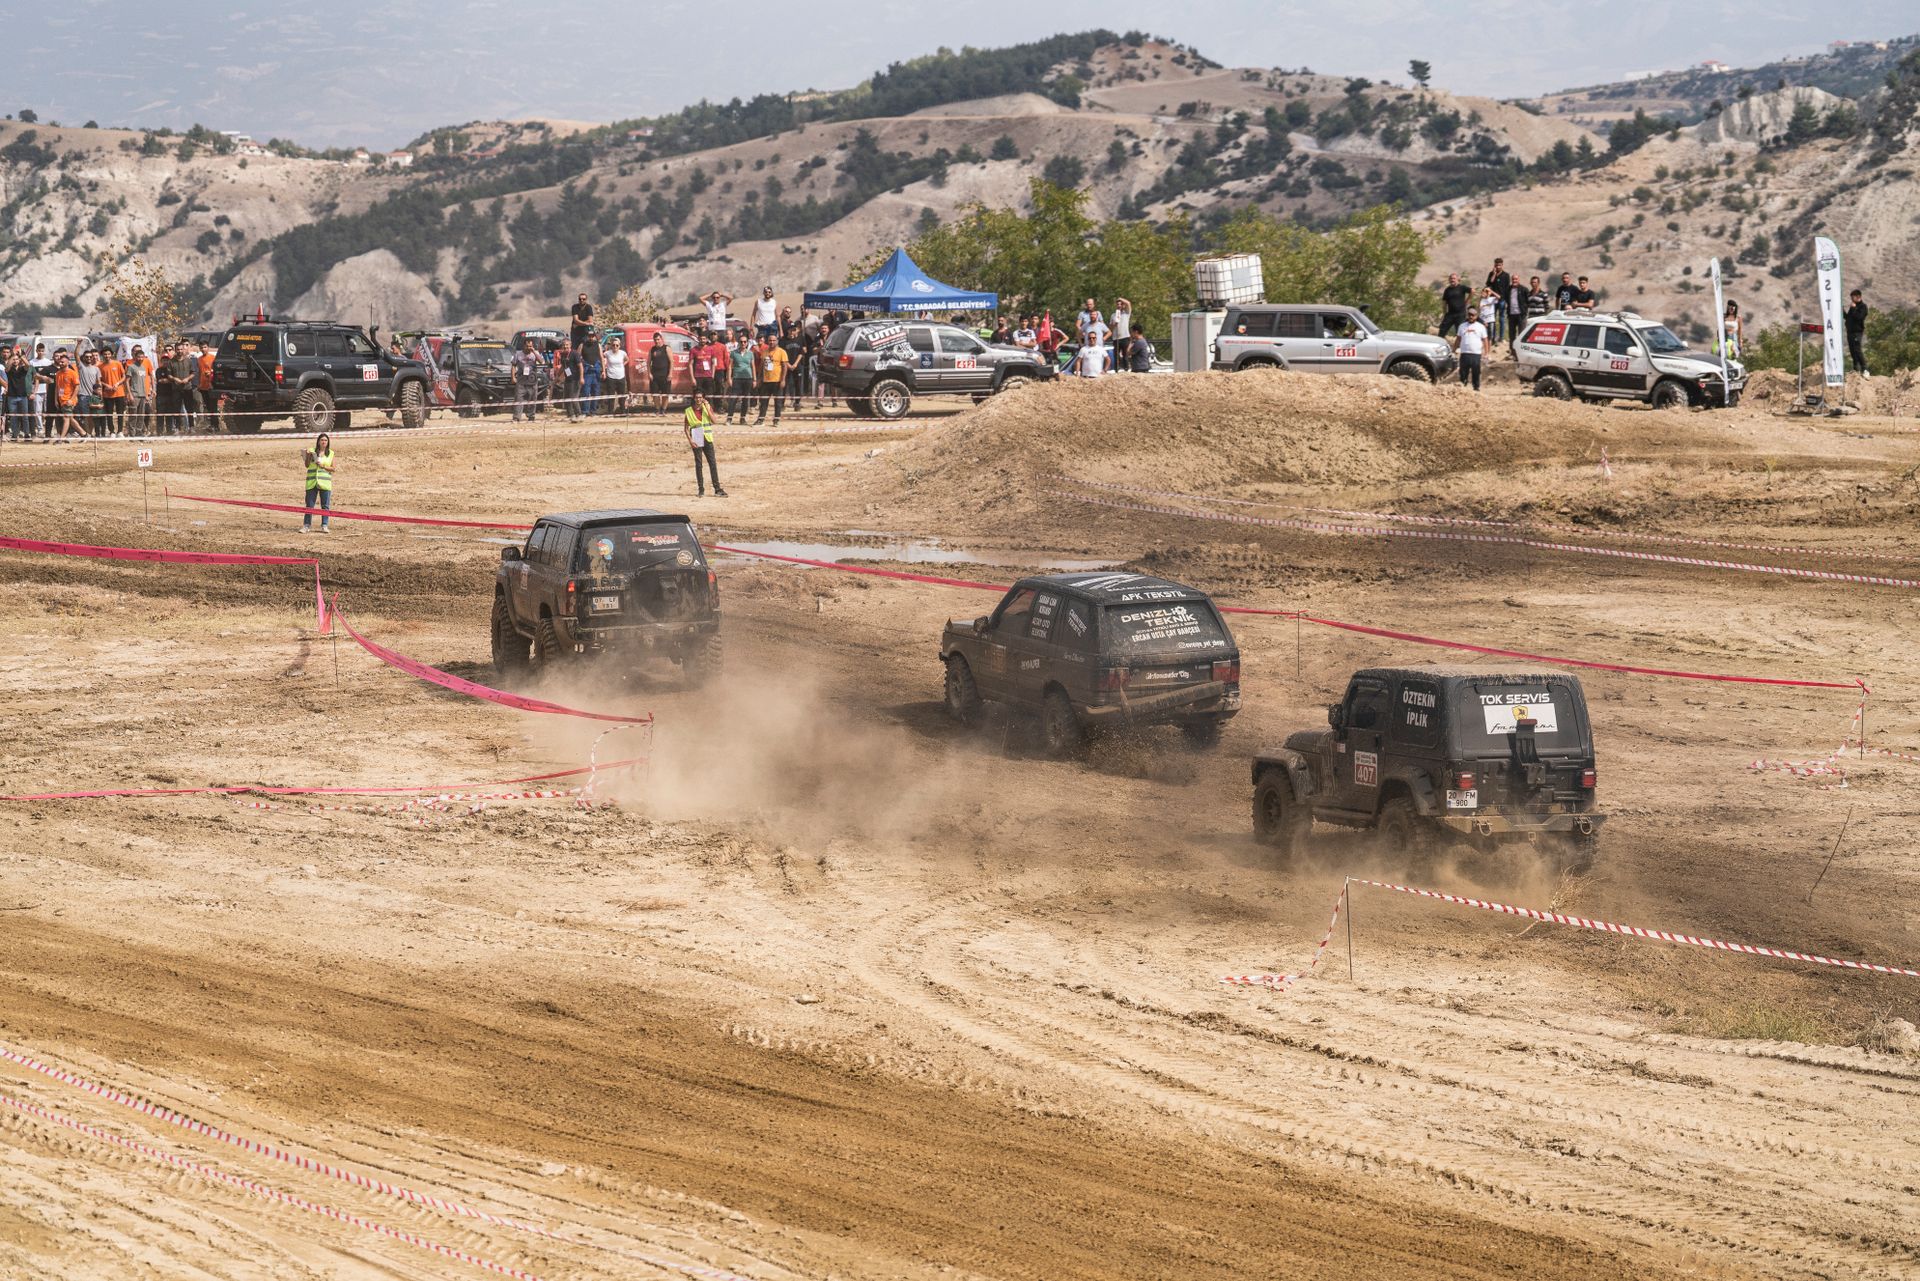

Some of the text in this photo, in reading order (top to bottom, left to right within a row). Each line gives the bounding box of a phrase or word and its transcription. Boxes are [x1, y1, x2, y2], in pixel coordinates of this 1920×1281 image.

[948, 301, 987, 309] BELEDİYESİ
[1337, 348, 1355, 357] 411
[957, 360, 975, 369] 412
[1611, 360, 1628, 370] 410
[1122, 592, 1143, 601] AFK
[1144, 613, 1197, 627] TEKNİK
[1402, 687, 1436, 708] ÖZTEKİN
[1479, 694, 1503, 705] TOK
[1406, 708, 1428, 728] İPLİK
[1357, 766, 1375, 782] 407
[1448, 791, 1476, 800] 20 FM
